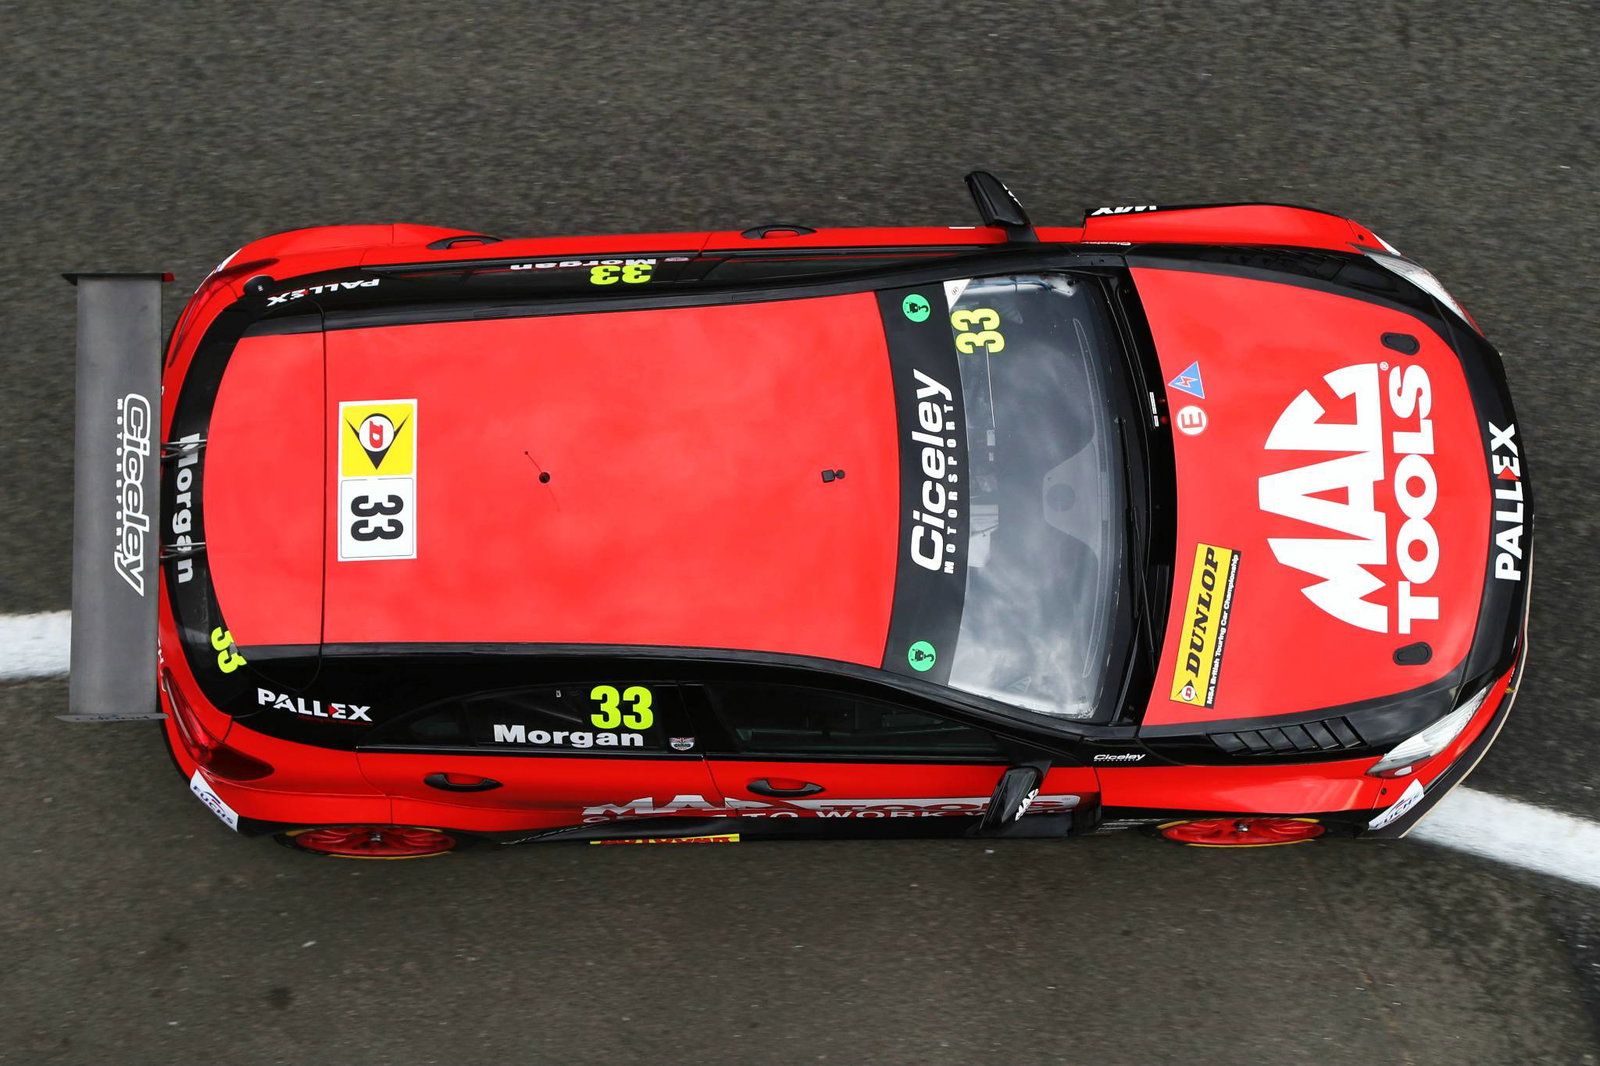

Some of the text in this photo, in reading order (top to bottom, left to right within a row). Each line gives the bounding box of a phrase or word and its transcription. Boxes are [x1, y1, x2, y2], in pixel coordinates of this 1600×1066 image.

[590, 264, 652, 285] 33
[950, 308, 1005, 354] 33
[115, 398, 124, 552] MOTORSPORT
[911, 368, 952, 571] Ciceley
[944, 404, 959, 574] MOTORSPORT
[1181, 411, 1203, 428] E
[114, 393, 151, 597] Ciceley
[172, 433, 200, 583] Morgan
[351, 494, 404, 542] 33
[1258, 363, 1388, 633] MAC
[1388, 364, 1440, 634] TOOLS
[1488, 421, 1524, 581] PALLEX
[1186, 547, 1219, 678] DUNLOP
[1206, 554, 1239, 705] MSA British Touring Car Championship
[257, 687, 373, 722] PALLEX
[493, 724, 644, 748] Morgan
[590, 686, 653, 729] 33
[1093, 753, 1146, 762] Ciceley
